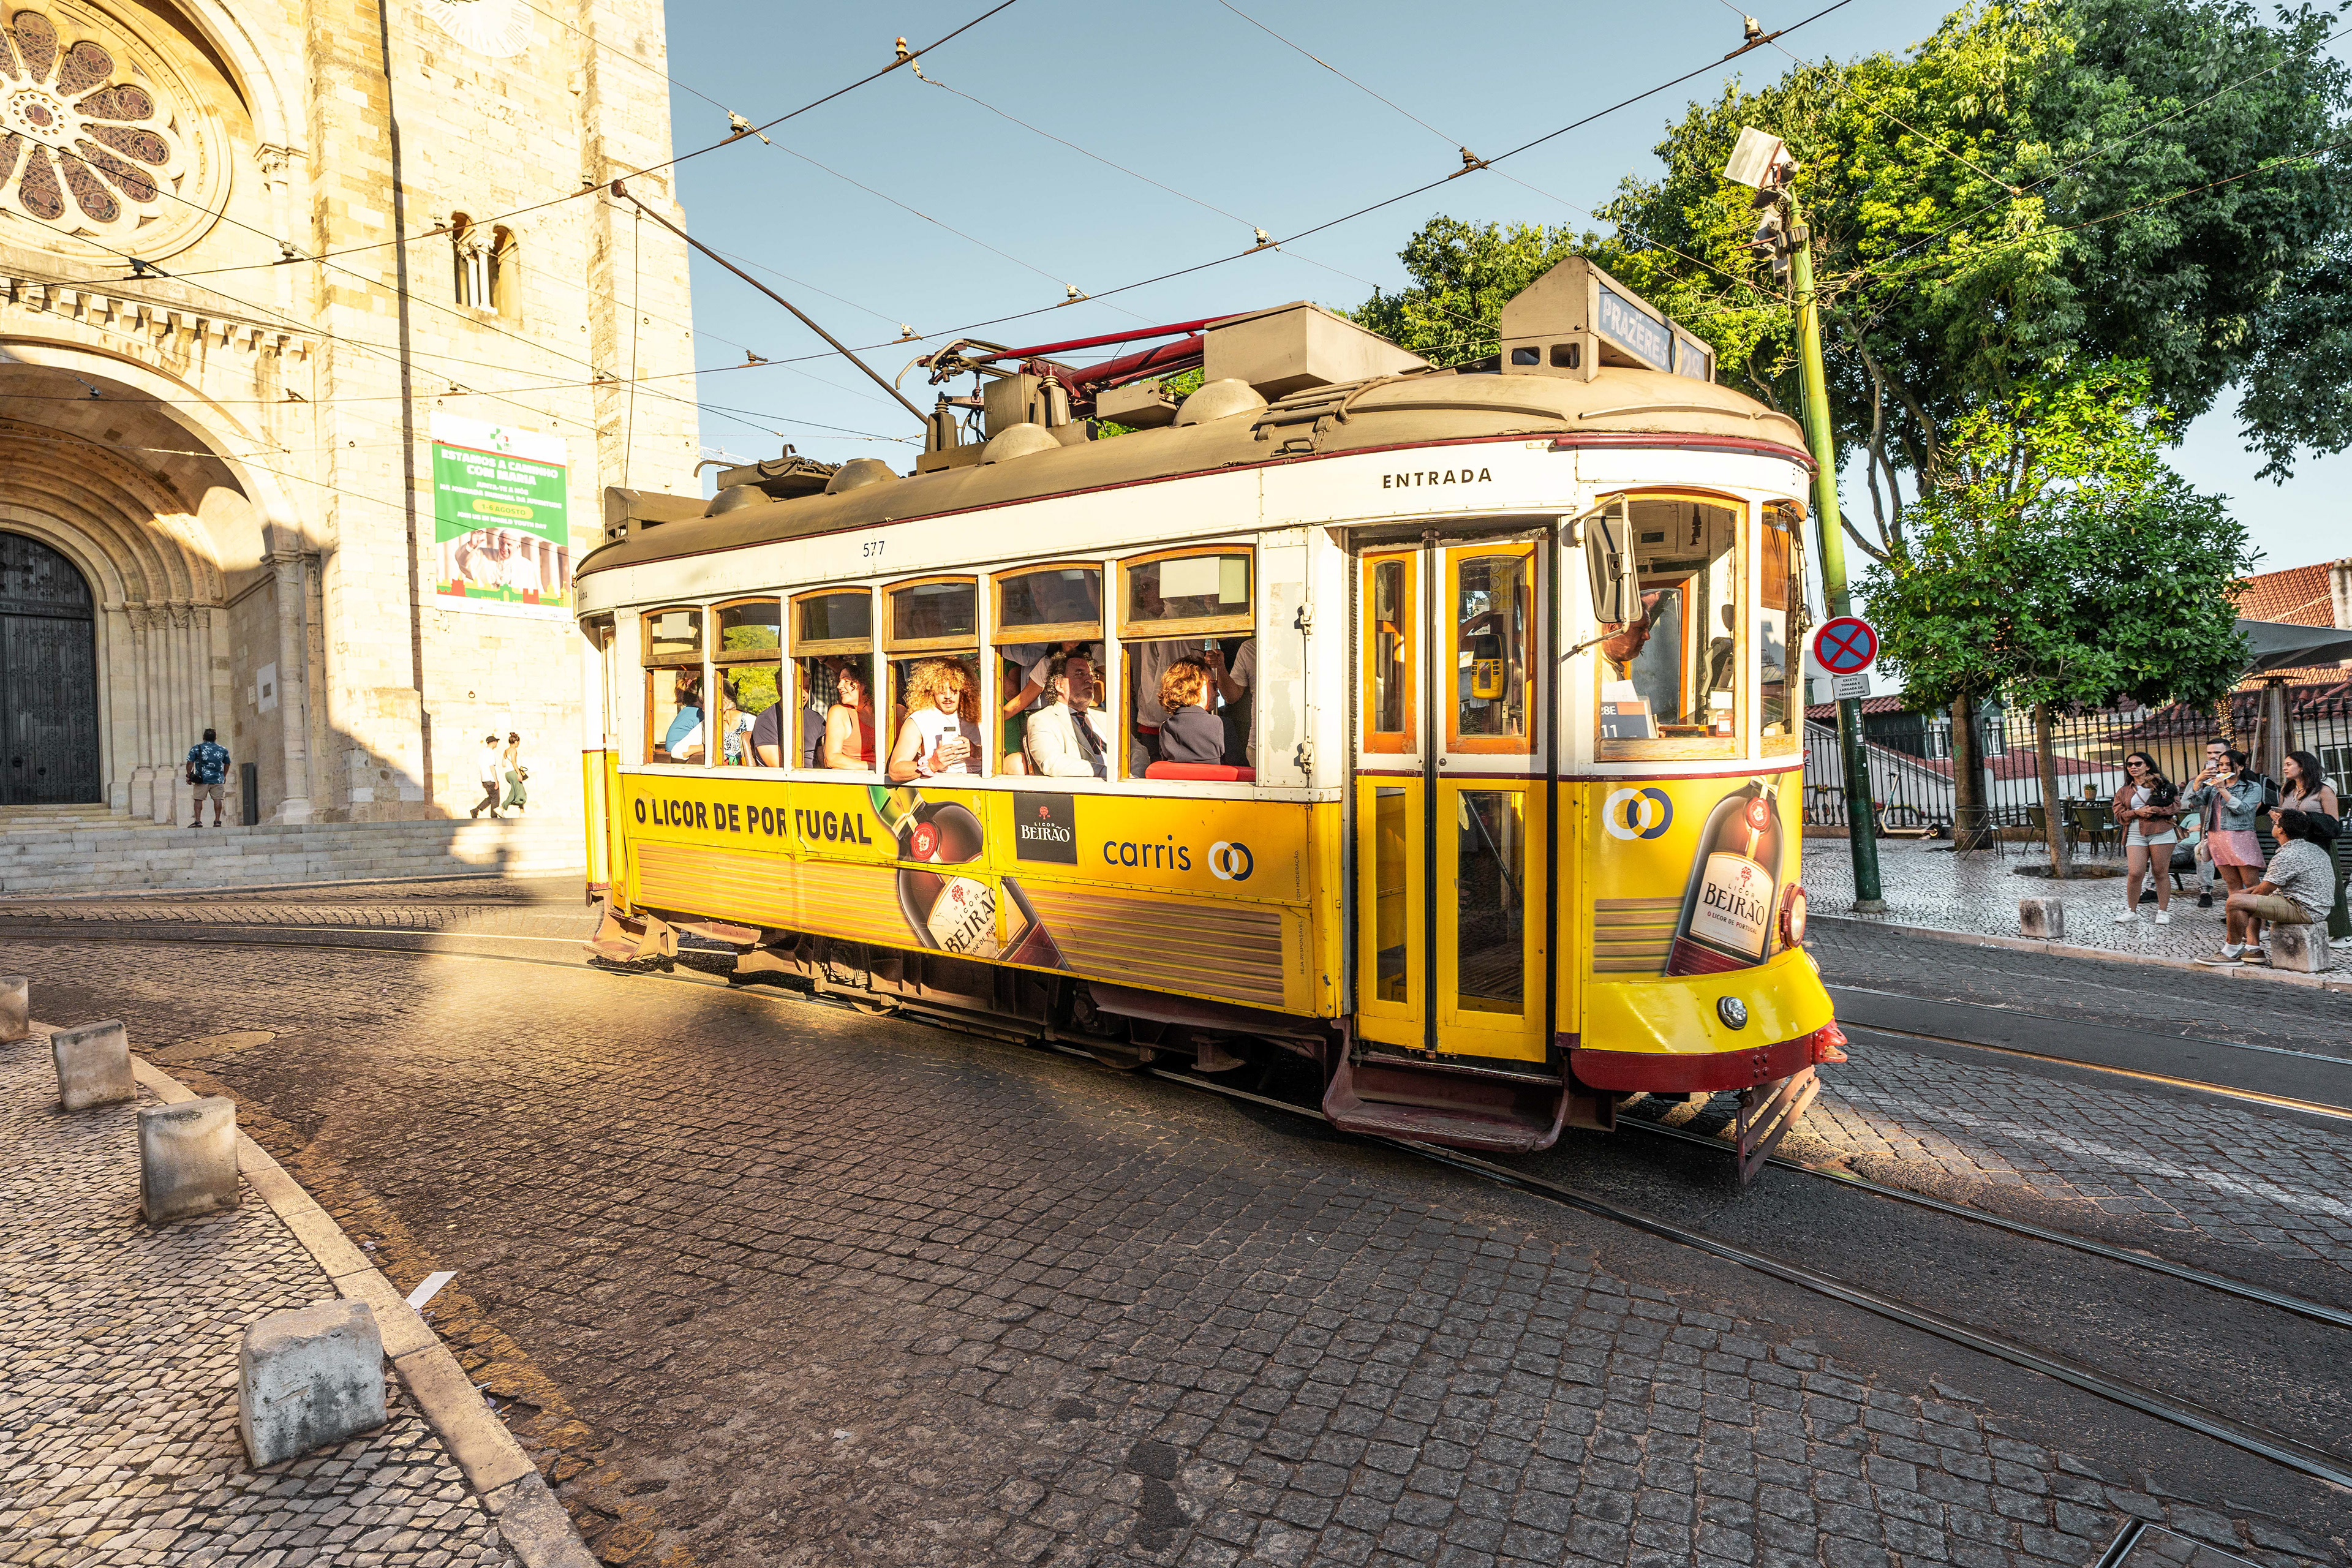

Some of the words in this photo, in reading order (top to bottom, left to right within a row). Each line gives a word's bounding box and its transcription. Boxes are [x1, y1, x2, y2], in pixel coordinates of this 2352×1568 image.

[1602, 295, 1667, 366] PRAZERES
[441, 448, 496, 467] ESTAMOS
[498, 460, 507, 470] A
[508, 461, 558, 478] CAMINHO
[466, 465, 495, 478] COM
[496, 470, 537, 485] MARIA
[1383, 468, 1491, 489] ENTRADA
[451, 486, 483, 496] JORNADA
[484, 491, 515, 502] MUNDIAL
[527, 498, 562, 509] JUVENTUDE
[490, 516, 513, 524] WORLD
[495, 506, 526, 516] AGOSTO
[863, 541, 884, 557] 577
[635, 798, 646, 823] O
[652, 799, 708, 829] LICOR
[714, 802, 741, 832] DE
[747, 805, 872, 845] PORTUGAL
[1020, 824, 1070, 842] BEIRÃO
[1103, 834, 1191, 871] carris
[1728, 883, 1755, 899] LICOR
[955, 894, 979, 925] LICOR
[1703, 882, 1764, 925] BEIRÃO
[1712, 913, 1727, 922] LICOR
[1736, 922, 1757, 935] PORTUGAL
[979, 937, 986, 945] DE
